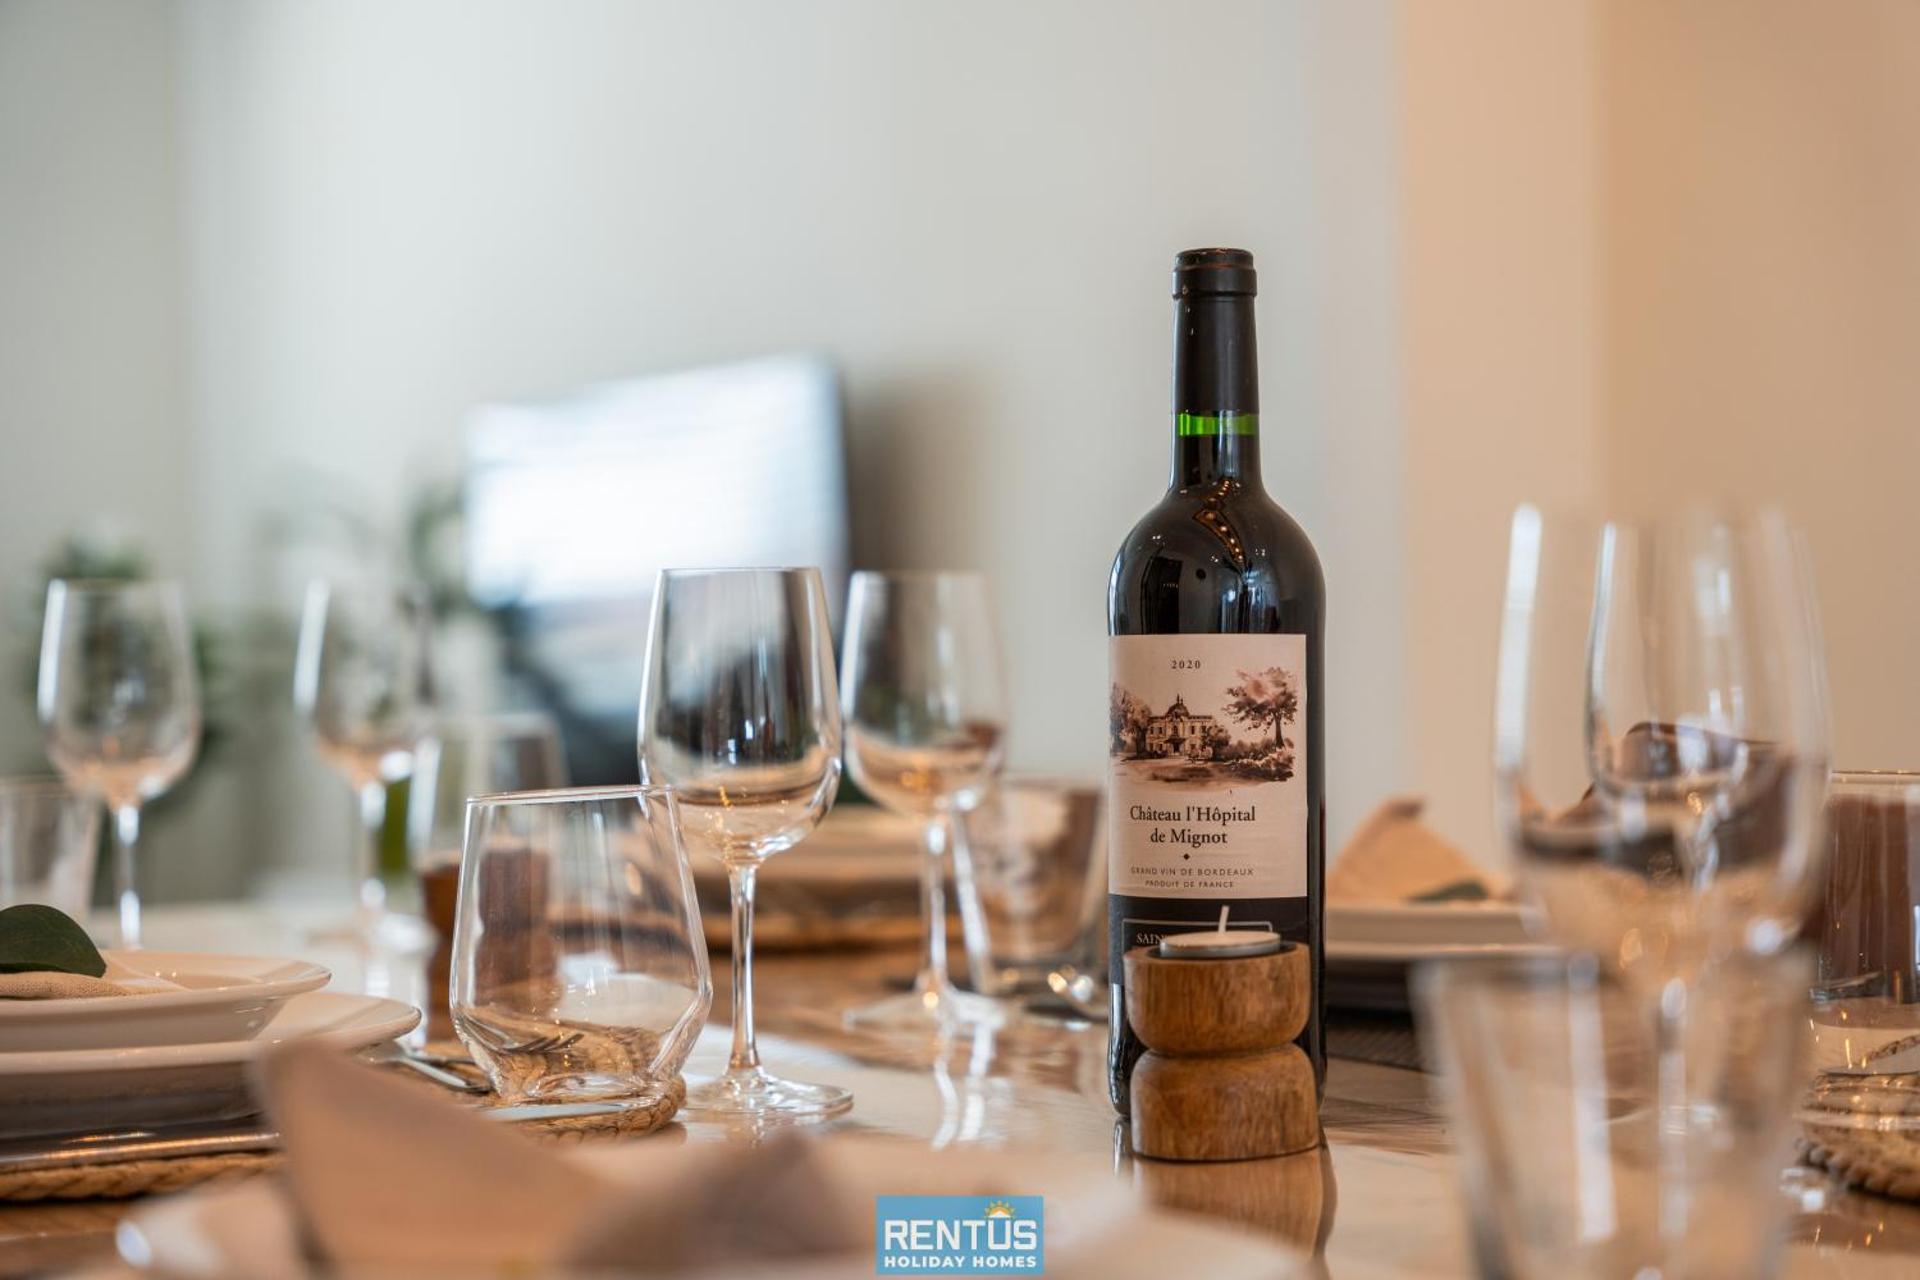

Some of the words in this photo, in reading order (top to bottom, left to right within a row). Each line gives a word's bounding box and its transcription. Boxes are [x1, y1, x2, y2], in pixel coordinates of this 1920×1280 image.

[1171, 660, 1201, 670] 2020
[1130, 805, 1181, 822] Château
[1186, 805, 1256, 825] l'Hôpital
[1150, 828, 1166, 844] de
[1170, 828, 1228, 848] Mignot
[1130, 867, 1158, 876] GRAND
[1161, 867, 1176, 876] VIN
[1180, 867, 1194, 876] DE
[1197, 867, 1254, 876] BORDEAUX
[1145, 880, 1179, 888] PRODUIT
[1184, 880, 1195, 888] DE
[1198, 880, 1234, 888] FRANCE
[1136, 932, 1166, 945] SAIN
